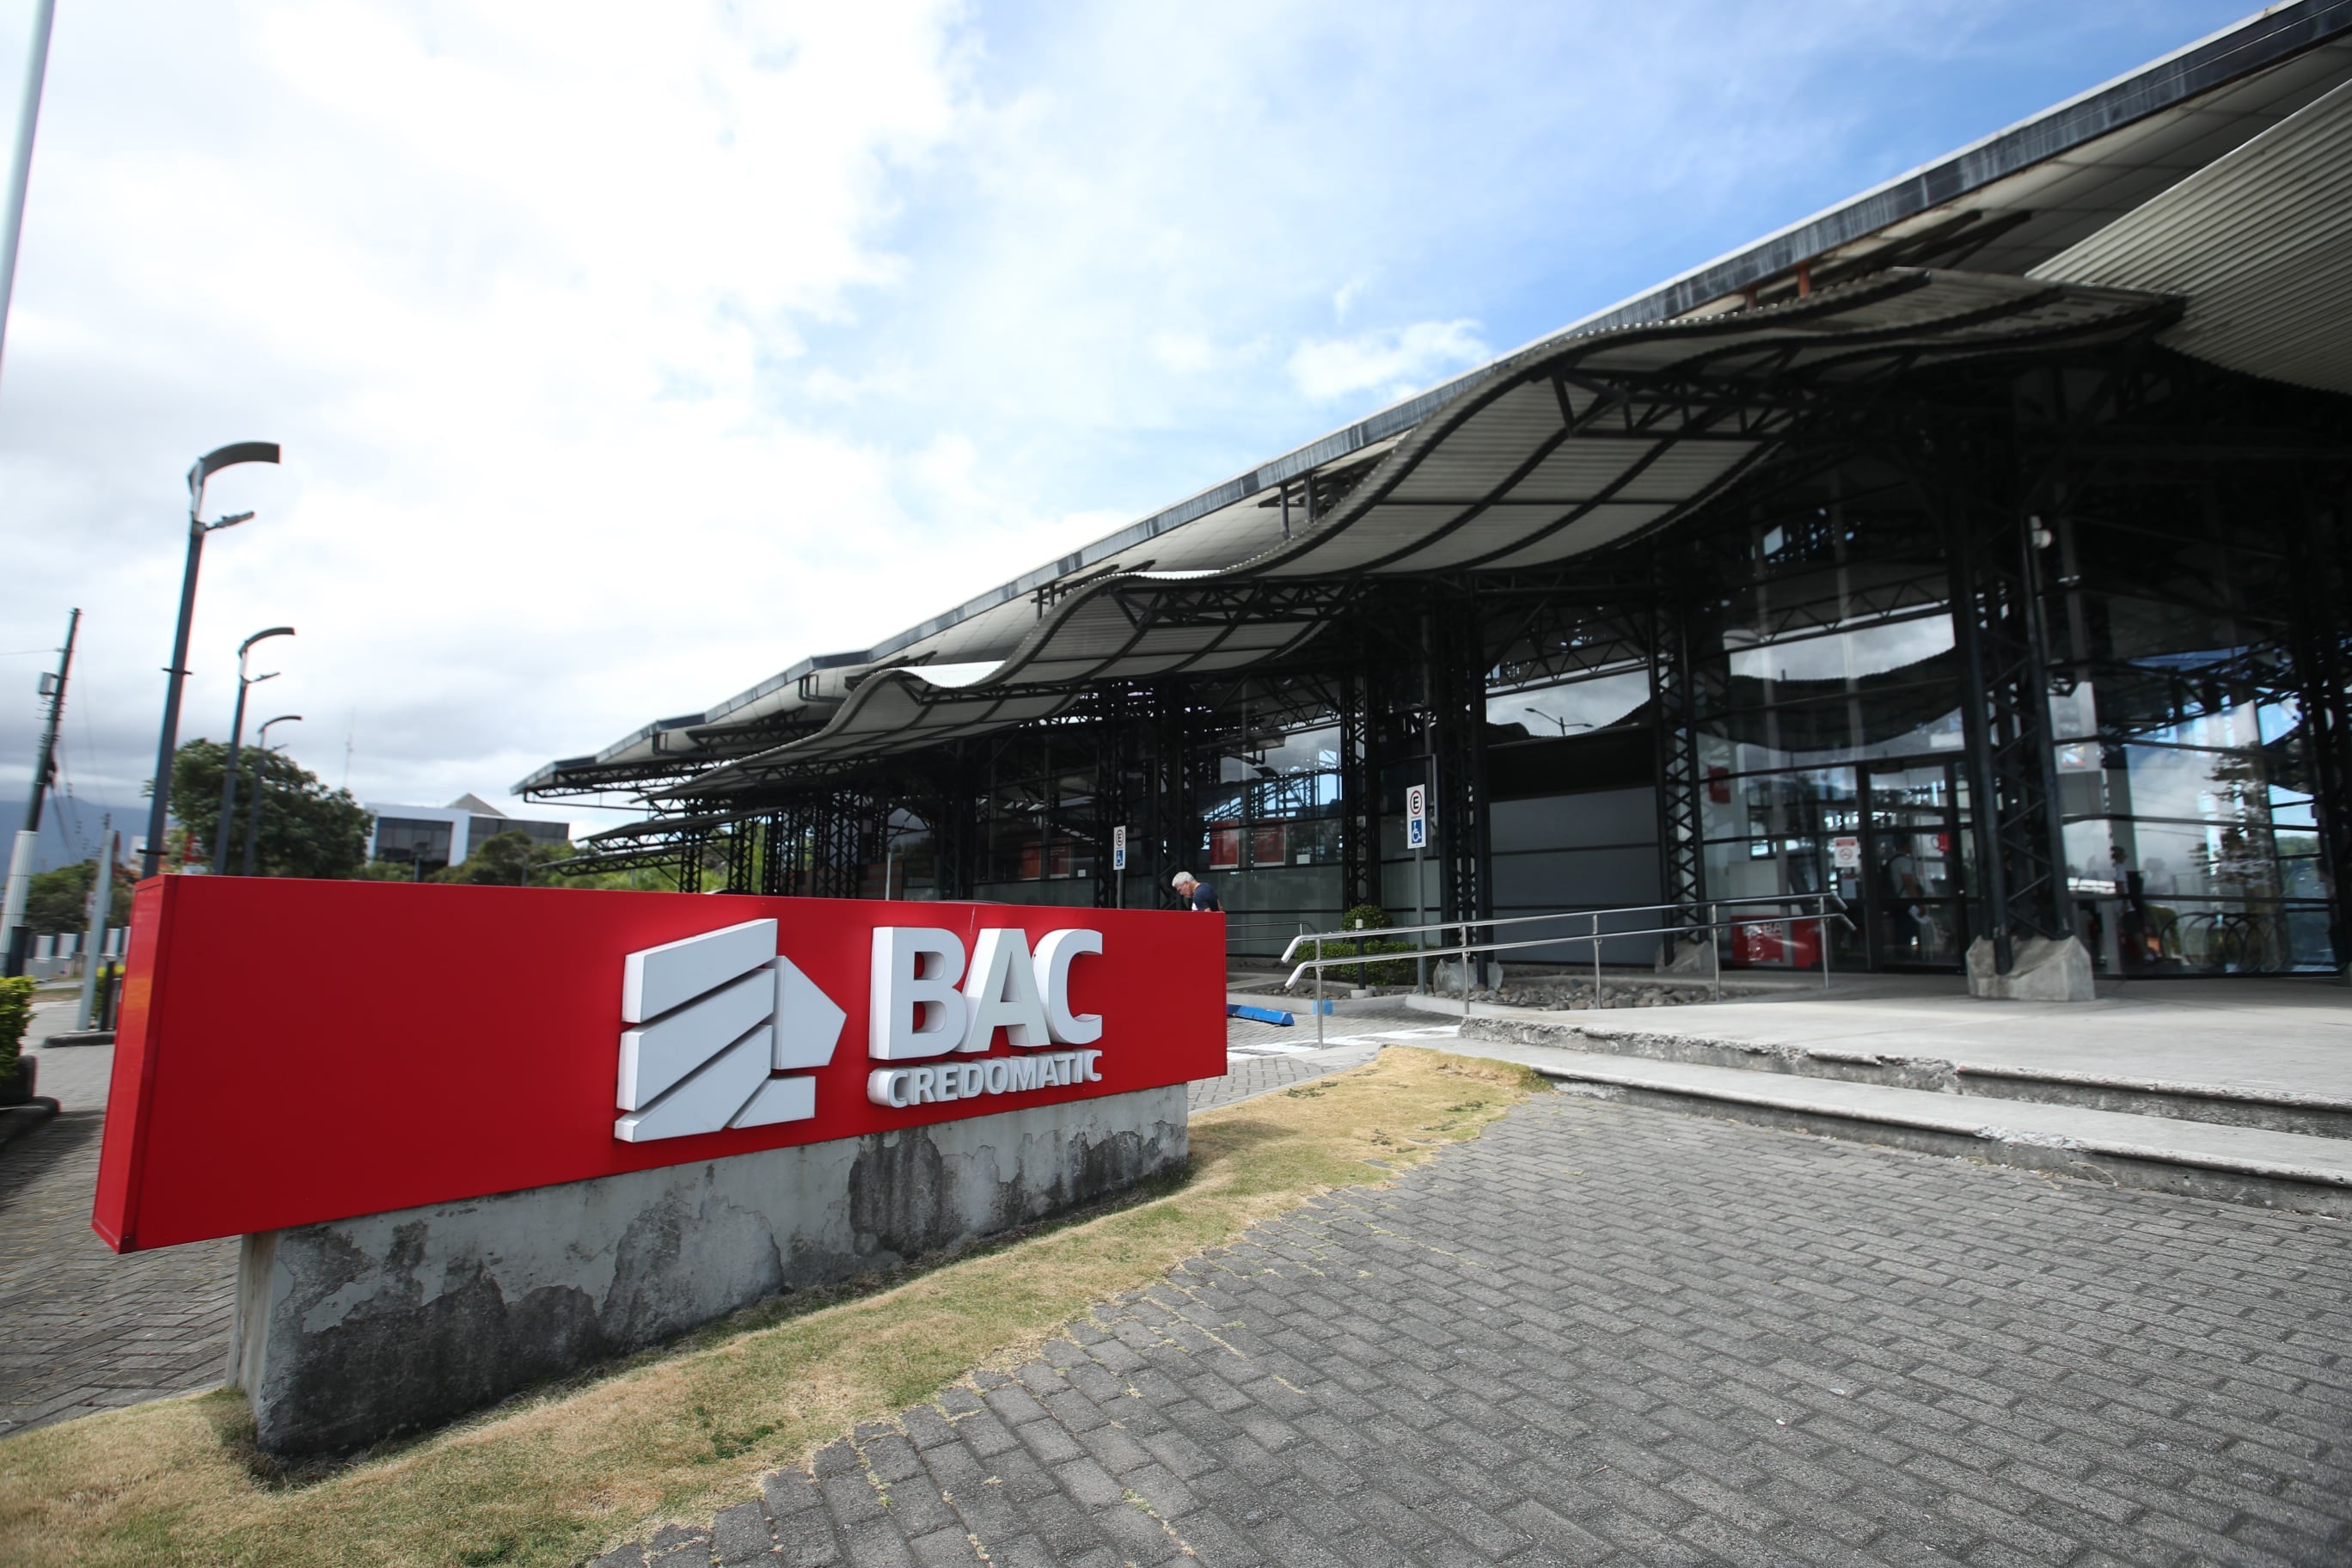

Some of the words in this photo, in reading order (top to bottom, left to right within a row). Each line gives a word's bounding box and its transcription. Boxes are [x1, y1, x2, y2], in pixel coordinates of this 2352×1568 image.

[1413, 796, 1419, 809] E
[868, 927, 1103, 1060] BAC
[867, 1049, 1103, 1108] CREDOMATIC
